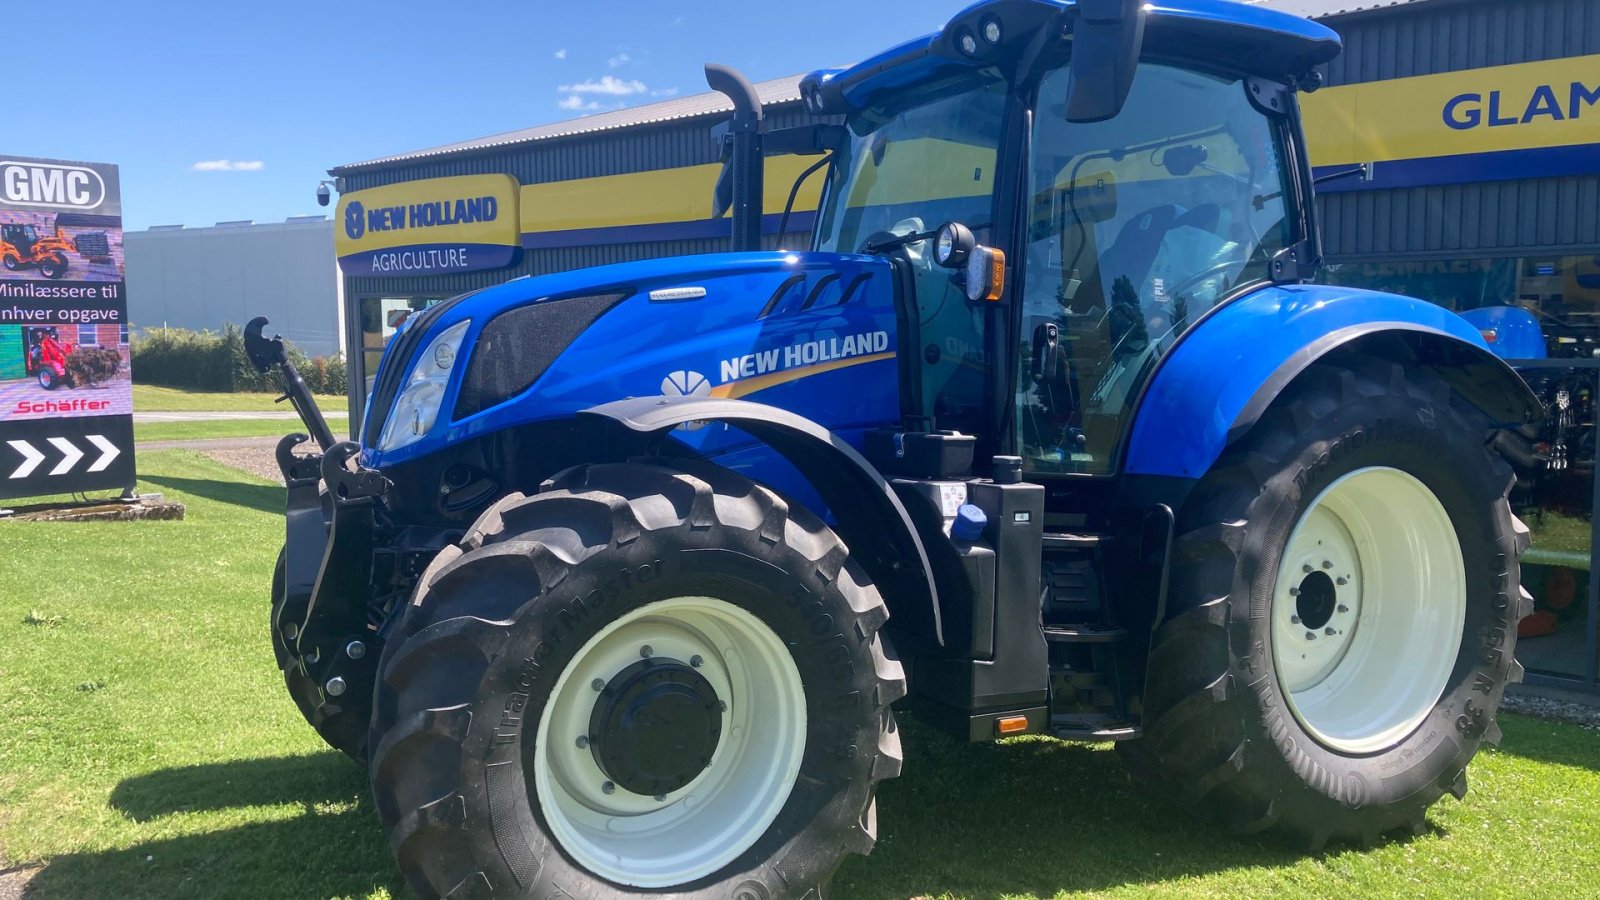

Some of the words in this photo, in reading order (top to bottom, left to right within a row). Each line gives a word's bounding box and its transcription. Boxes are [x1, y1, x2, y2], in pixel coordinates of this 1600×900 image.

[1442, 82, 1600, 130] GLAM
[4, 166, 90, 205] GMC
[368, 205, 406, 233] NEW
[409, 196, 498, 229] HOLLAND
[372, 248, 468, 272] AGRICULTURE
[101, 284, 118, 298] til
[58, 309, 119, 323] opgave
[720, 348, 780, 383] NEW
[784, 331, 889, 367] HOLLAND
[13, 400, 111, 414] Schäffer
[490, 559, 667, 749] TractorMaster
[1472, 671, 1496, 696] R
[1455, 698, 1484, 740] 38
